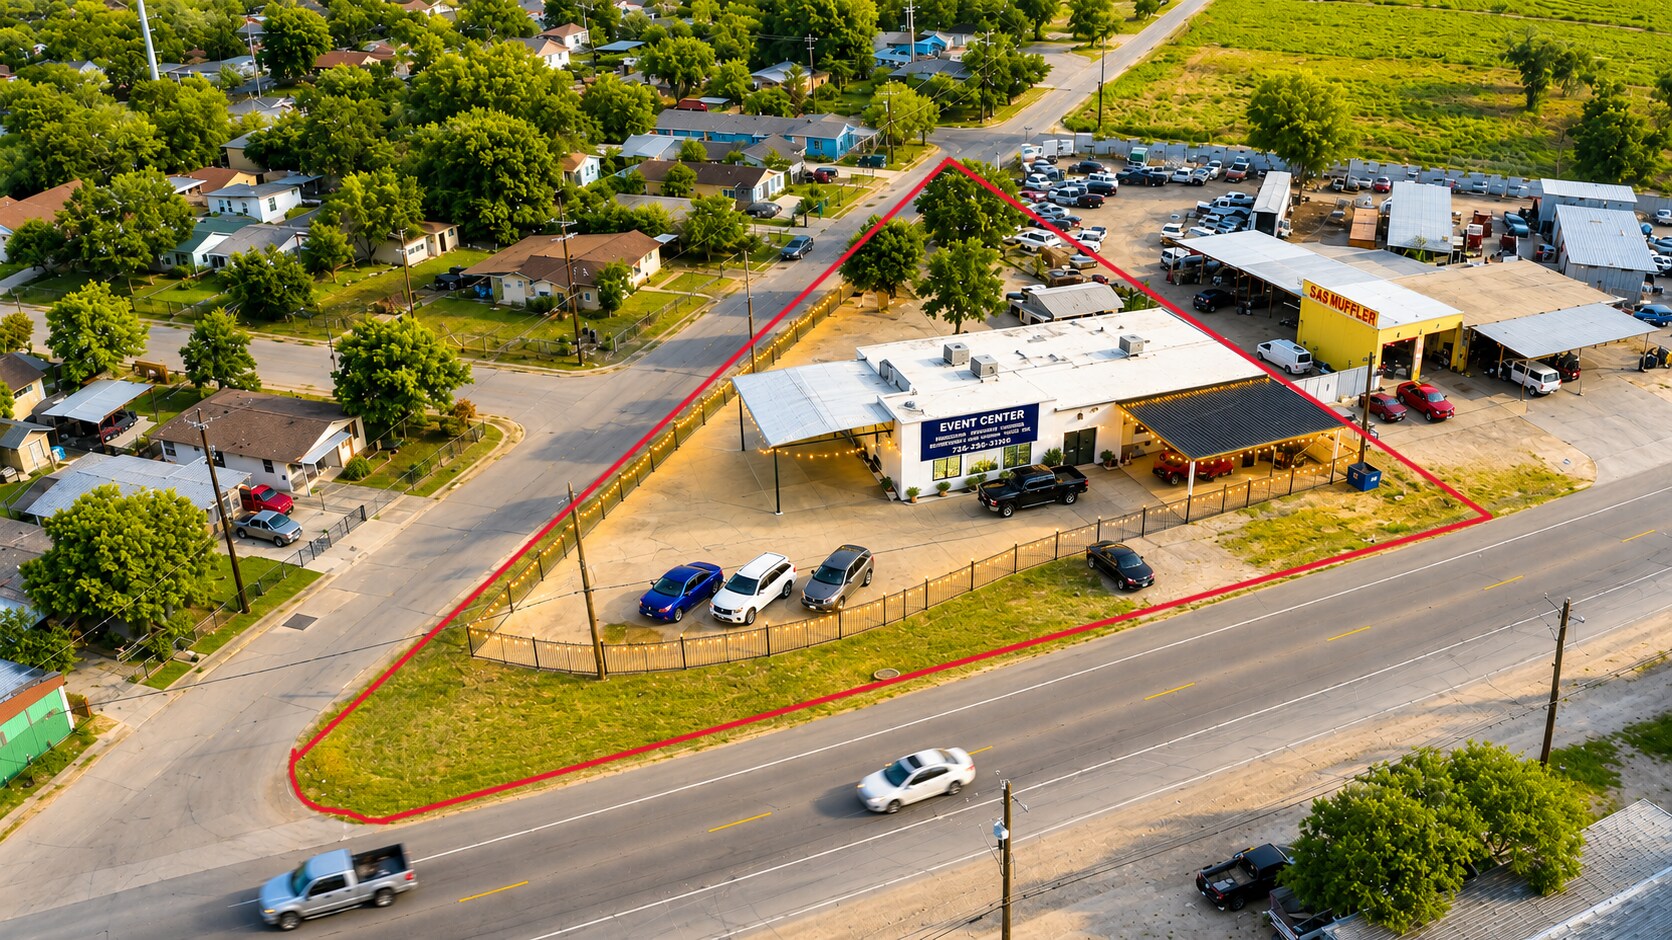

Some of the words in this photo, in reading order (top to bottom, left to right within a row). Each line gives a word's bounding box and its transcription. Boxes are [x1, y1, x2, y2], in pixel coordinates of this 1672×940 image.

[1309, 285, 1329, 305] SAS
[1329, 294, 1376, 327] MUFFLER
[940, 417, 978, 432] EVENT
[980, 409, 1025, 425] CENTER
